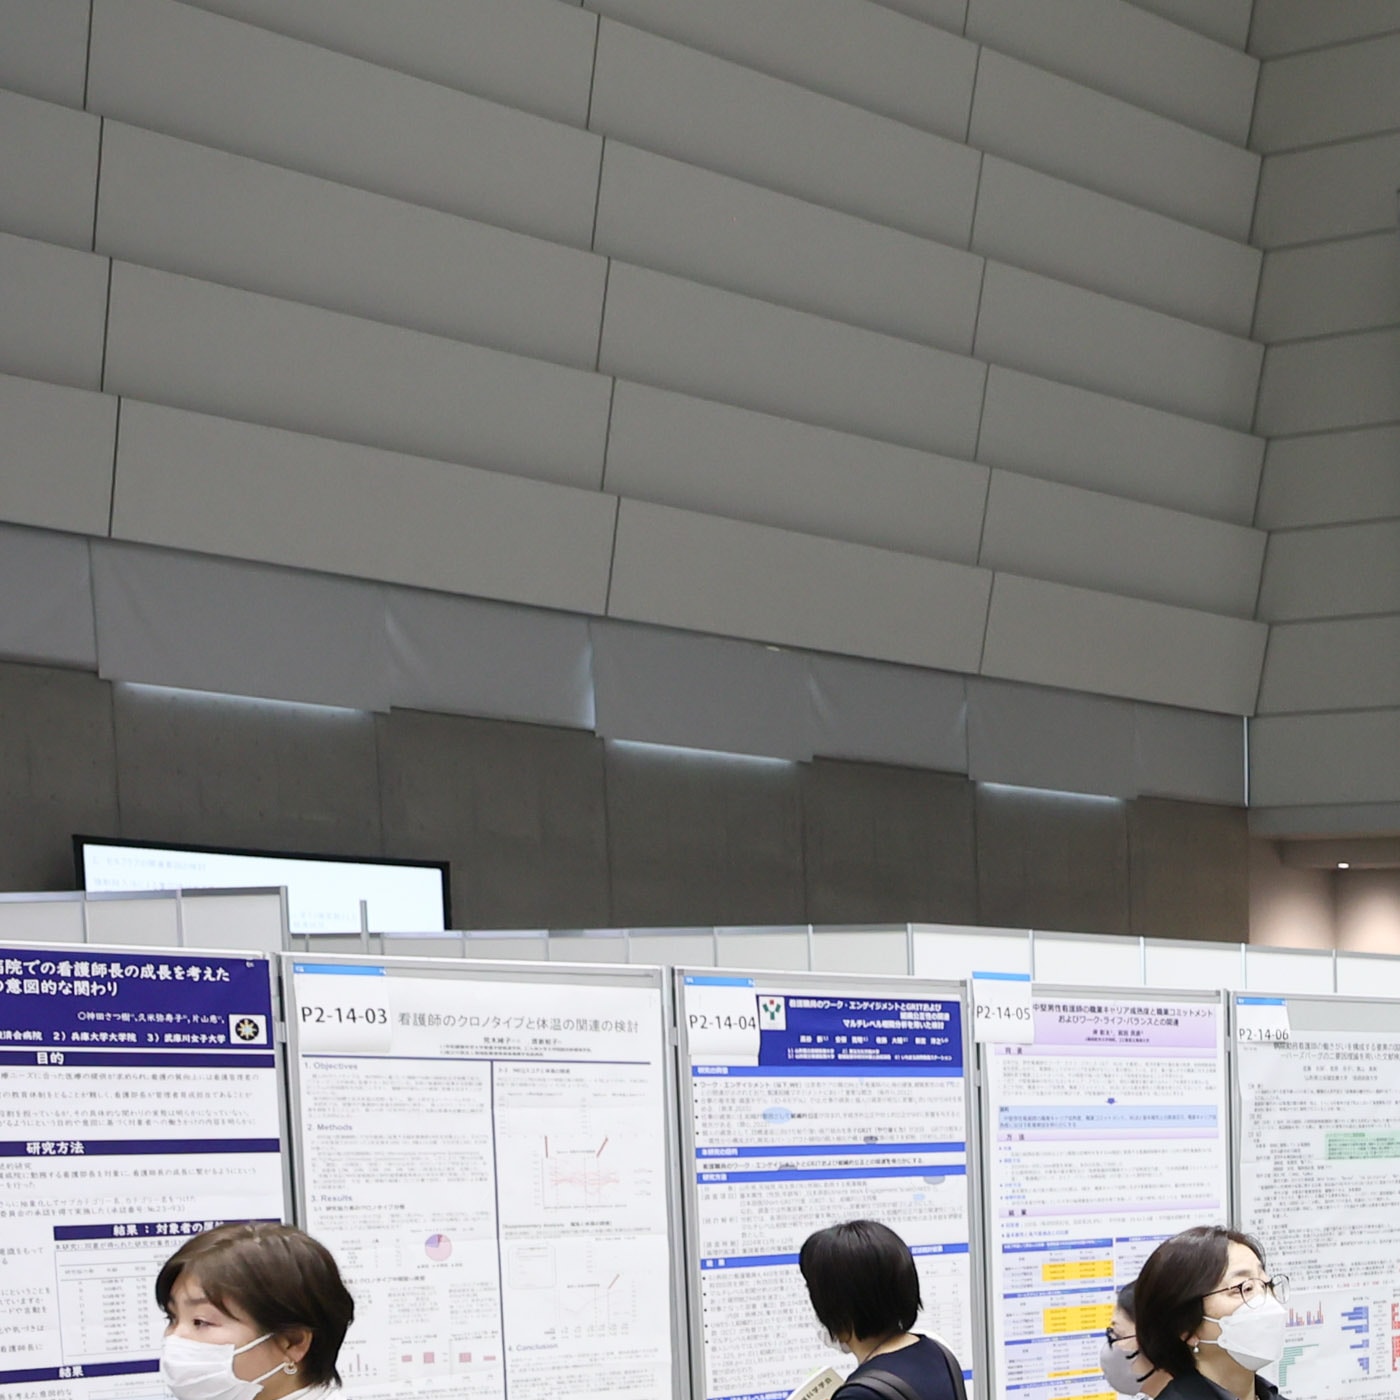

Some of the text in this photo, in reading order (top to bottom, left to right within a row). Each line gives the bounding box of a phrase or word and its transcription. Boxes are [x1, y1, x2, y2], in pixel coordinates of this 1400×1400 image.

[301, 1006, 388, 1025] P2-14-03
[976, 1005, 1031, 1021] P2-14-05
[689, 1014, 757, 1030] P2-14-04
[1238, 1028, 1290, 1041] P2-14-06
[36, 1051, 65, 1065] 目的
[26, 1141, 85, 1156] 研究方法
[58, 1366, 85, 1378] 結果
